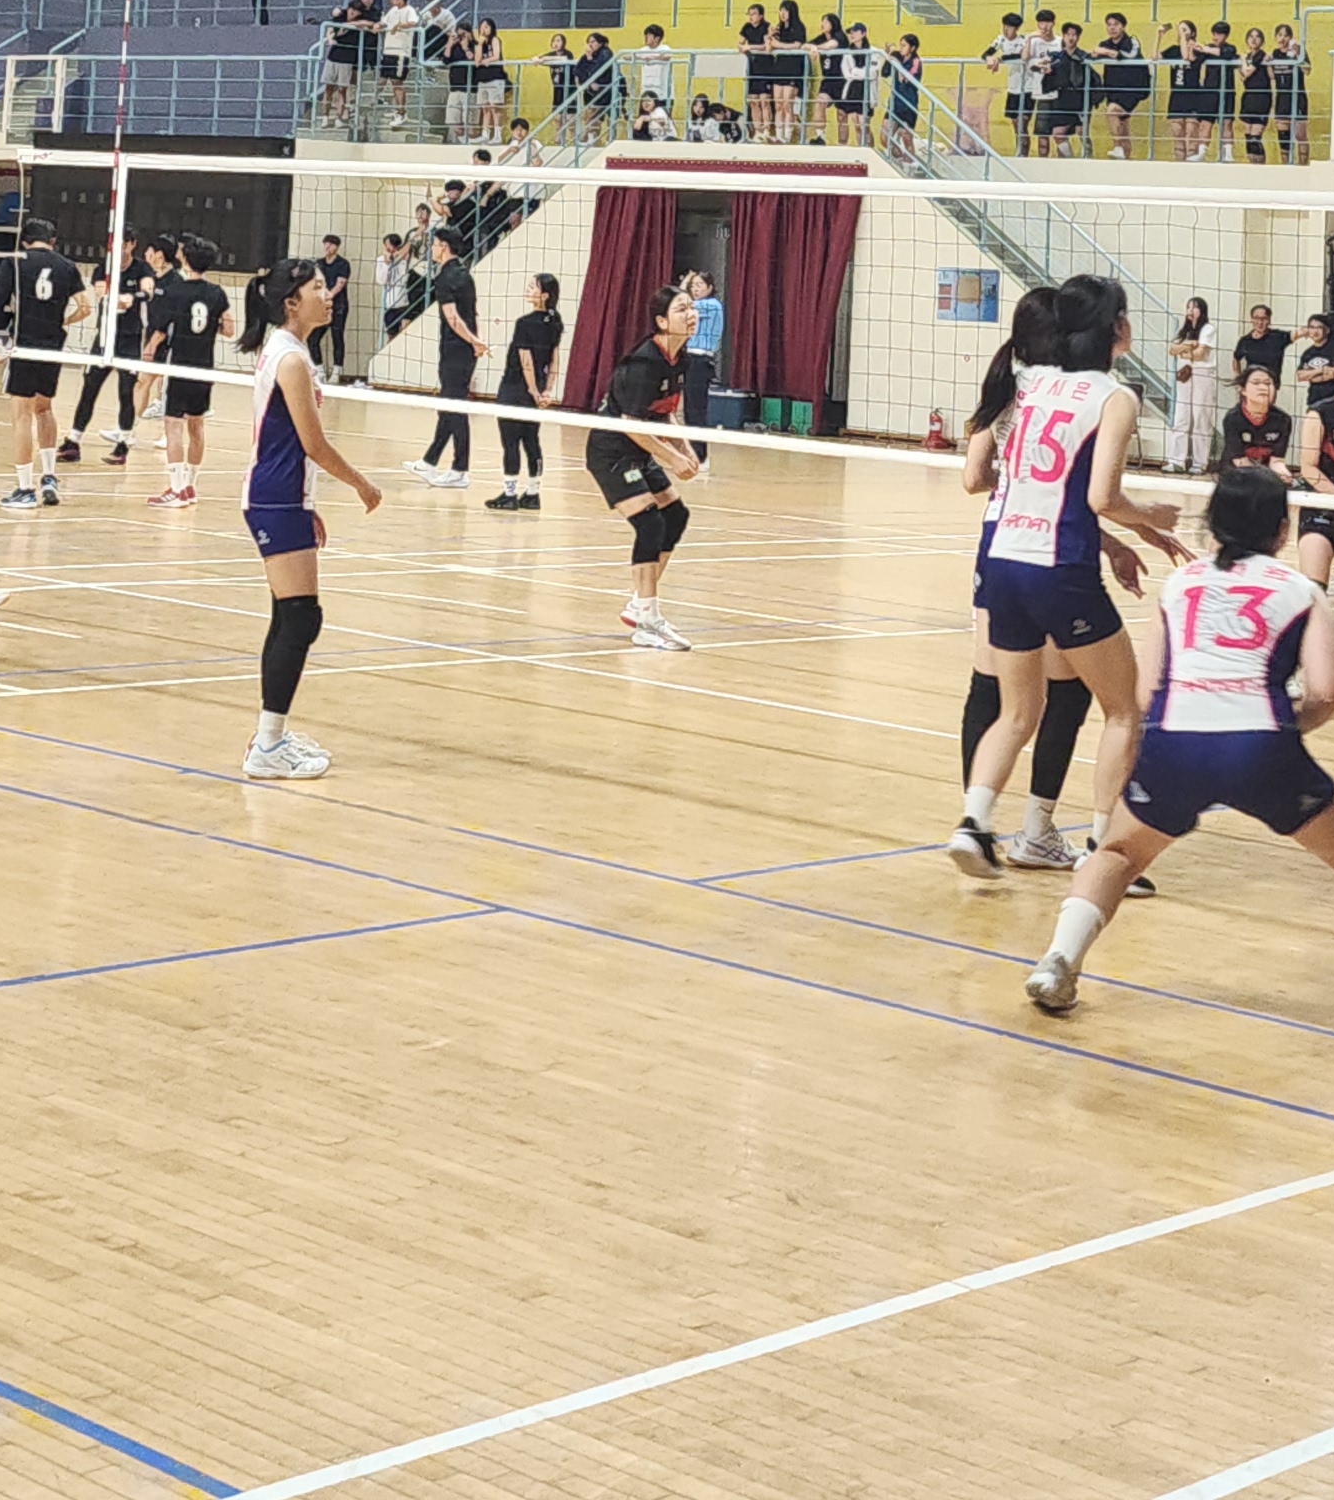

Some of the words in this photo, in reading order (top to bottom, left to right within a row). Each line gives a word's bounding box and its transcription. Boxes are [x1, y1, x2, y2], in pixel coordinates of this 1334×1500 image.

[35, 267, 54, 300] 6
[190, 301, 209, 334] 8
[1013, 405, 1075, 483] 15
[1182, 585, 1277, 649] 13
